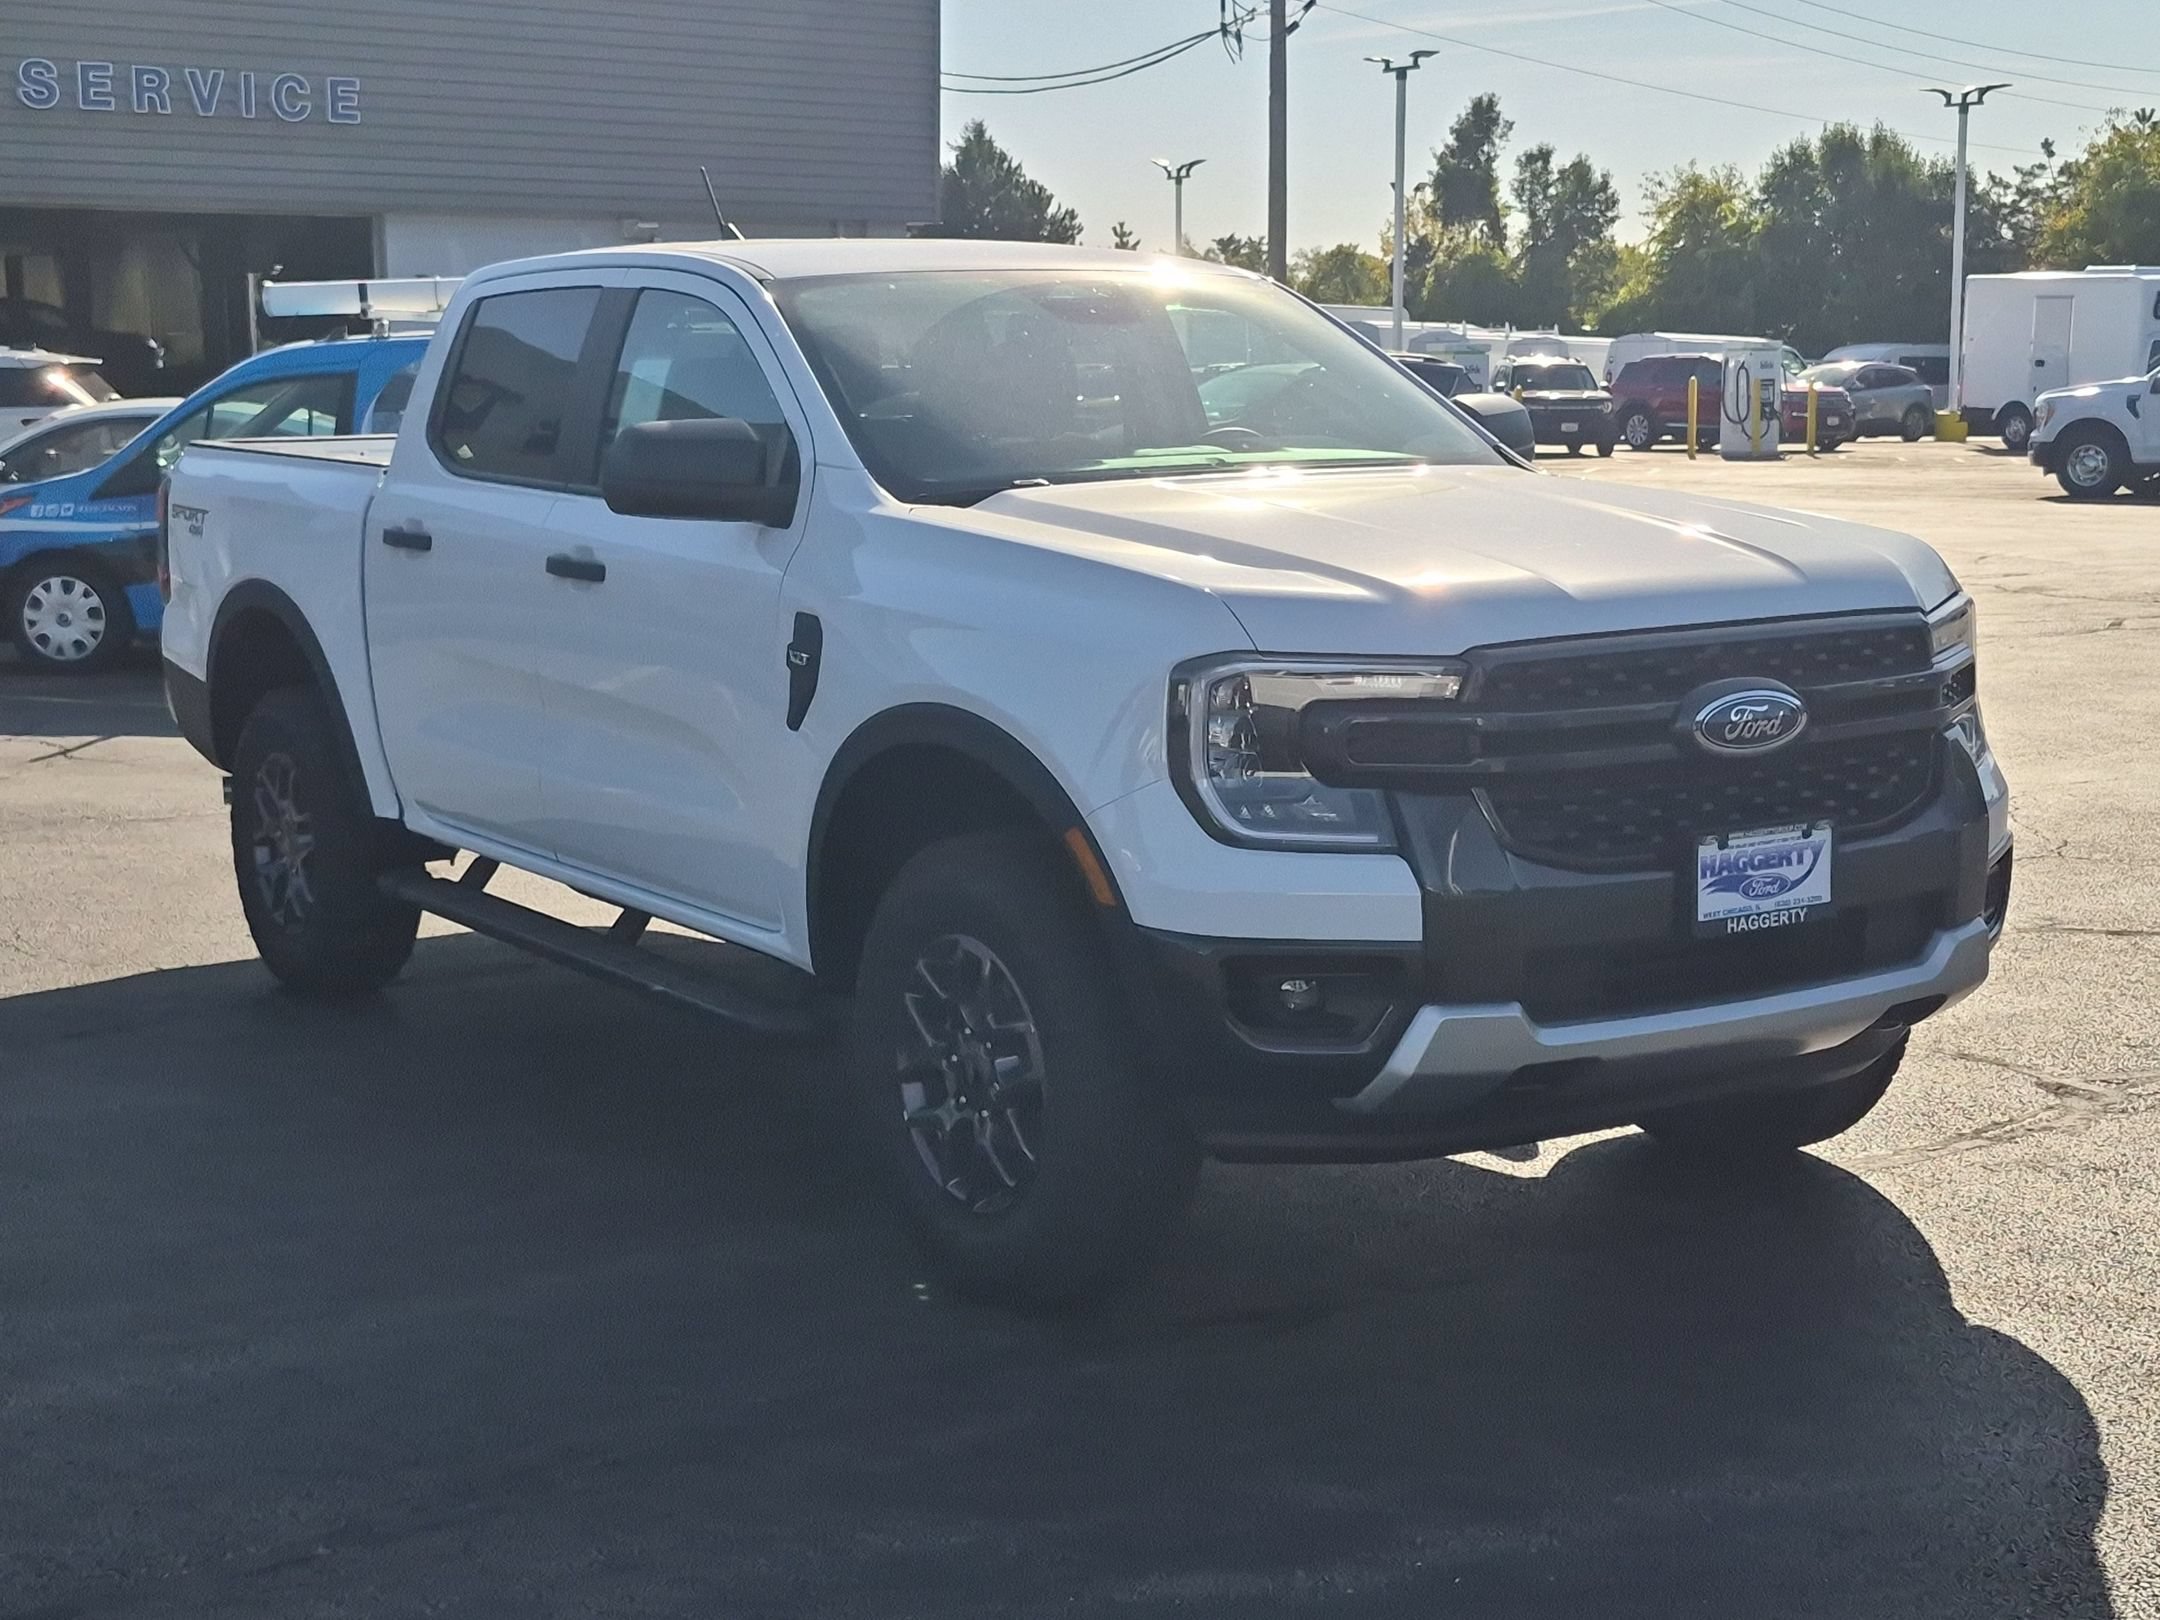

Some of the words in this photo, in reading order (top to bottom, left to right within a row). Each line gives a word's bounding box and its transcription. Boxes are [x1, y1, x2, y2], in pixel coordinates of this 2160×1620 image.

[18, 58, 361, 124] SERVICE
[172, 503, 210, 525] SPORT
[1724, 704, 1784, 741] Ford
[1700, 840, 1827, 880] HAGGERTY
[1748, 877, 1781, 897] Ford
[1727, 907, 1808, 934] HAGGERTY
